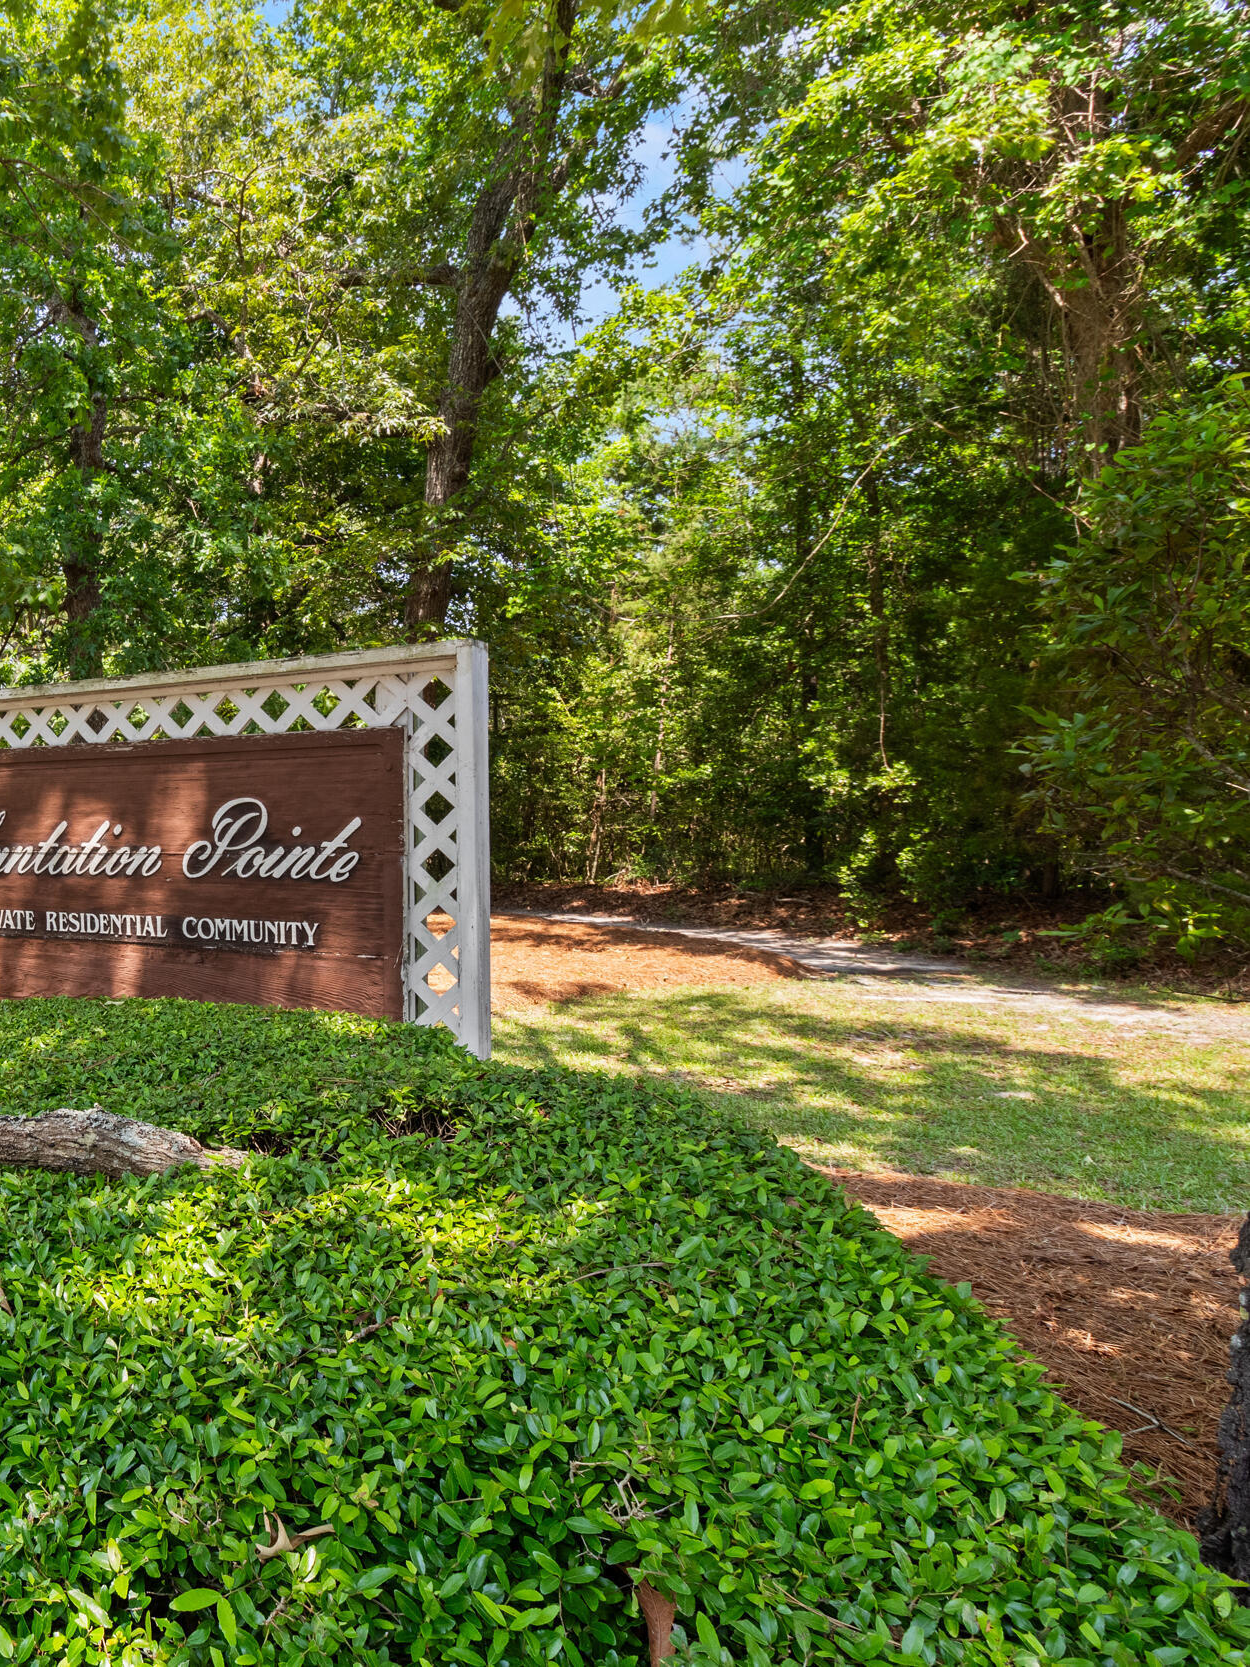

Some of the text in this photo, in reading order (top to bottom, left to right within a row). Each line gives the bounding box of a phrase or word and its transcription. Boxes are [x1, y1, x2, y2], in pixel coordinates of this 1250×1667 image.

[182, 797, 361, 882] Pointe
[46, 911, 168, 938] RESIDENTIAL
[182, 916, 319, 946] COMMUNITY
